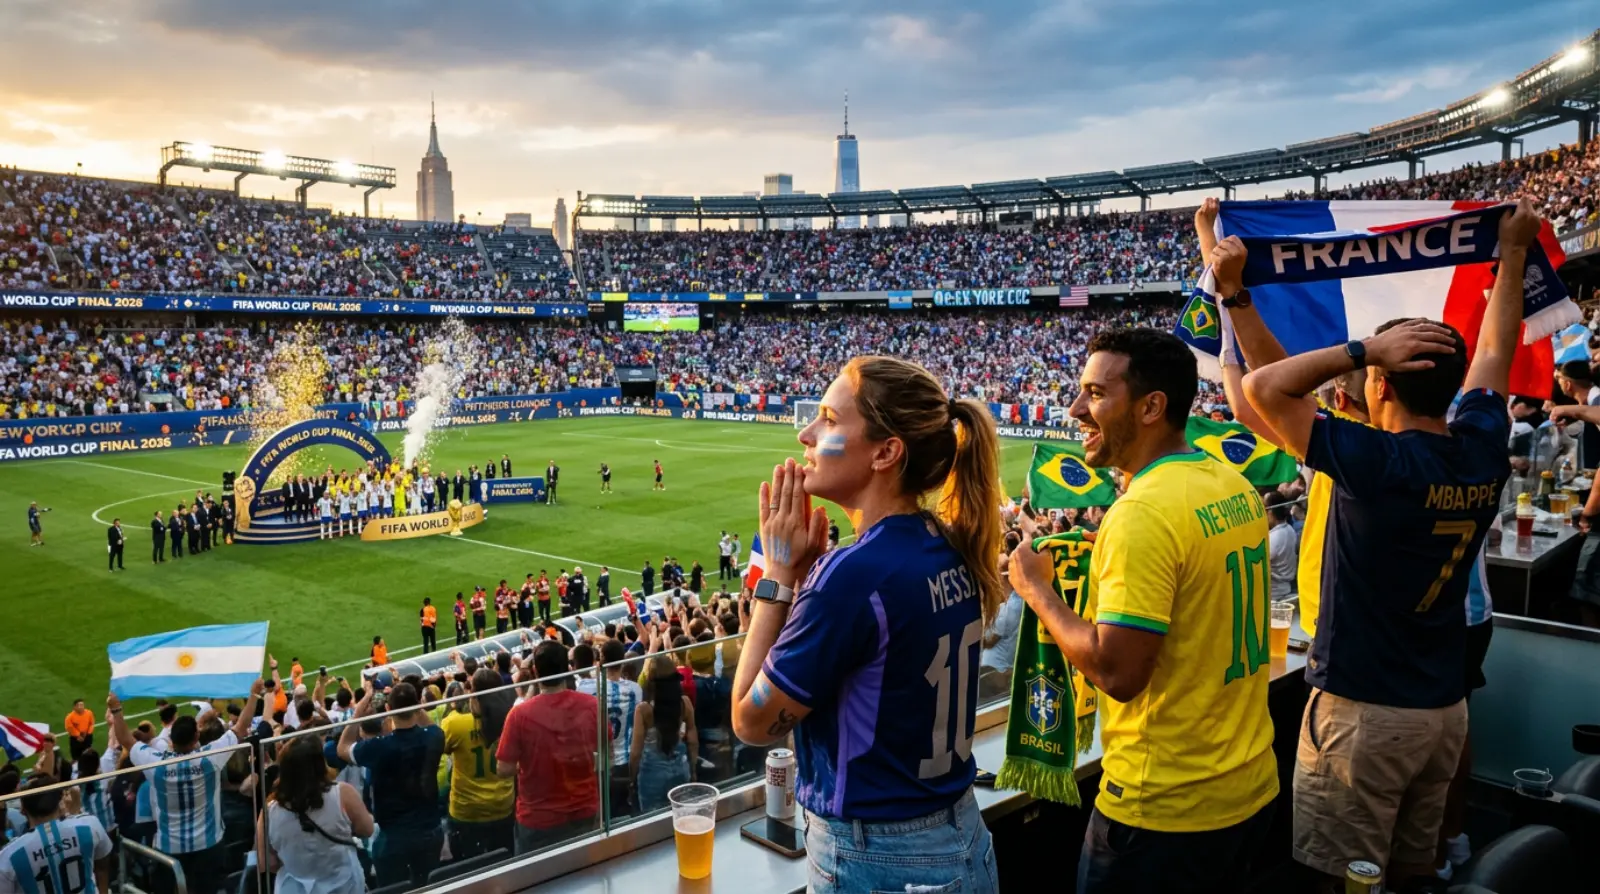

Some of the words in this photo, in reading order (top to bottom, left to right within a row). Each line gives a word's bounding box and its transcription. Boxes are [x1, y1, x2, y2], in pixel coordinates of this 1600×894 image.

[1271, 216, 1482, 274] FRANCE
[3, 294, 49, 306] WORLD
[51, 296, 75, 306] CUP
[77, 297, 112, 307] FINAL
[233, 300, 254, 309] FIFA
[255, 301, 290, 310] WORLD
[291, 301, 311, 310] CUP
[1024, 428, 1043, 438] CUP
[17, 445, 68, 457] WORLD
[71, 442, 97, 454] CUP
[100, 439, 138, 451] FINAL
[381, 524, 407, 535] FIFA
[1415, 520, 1476, 612] 7
[1224, 538, 1270, 686] 10
[1020, 732, 1064, 755] BRASIL
[35, 855, 86, 894] 10
